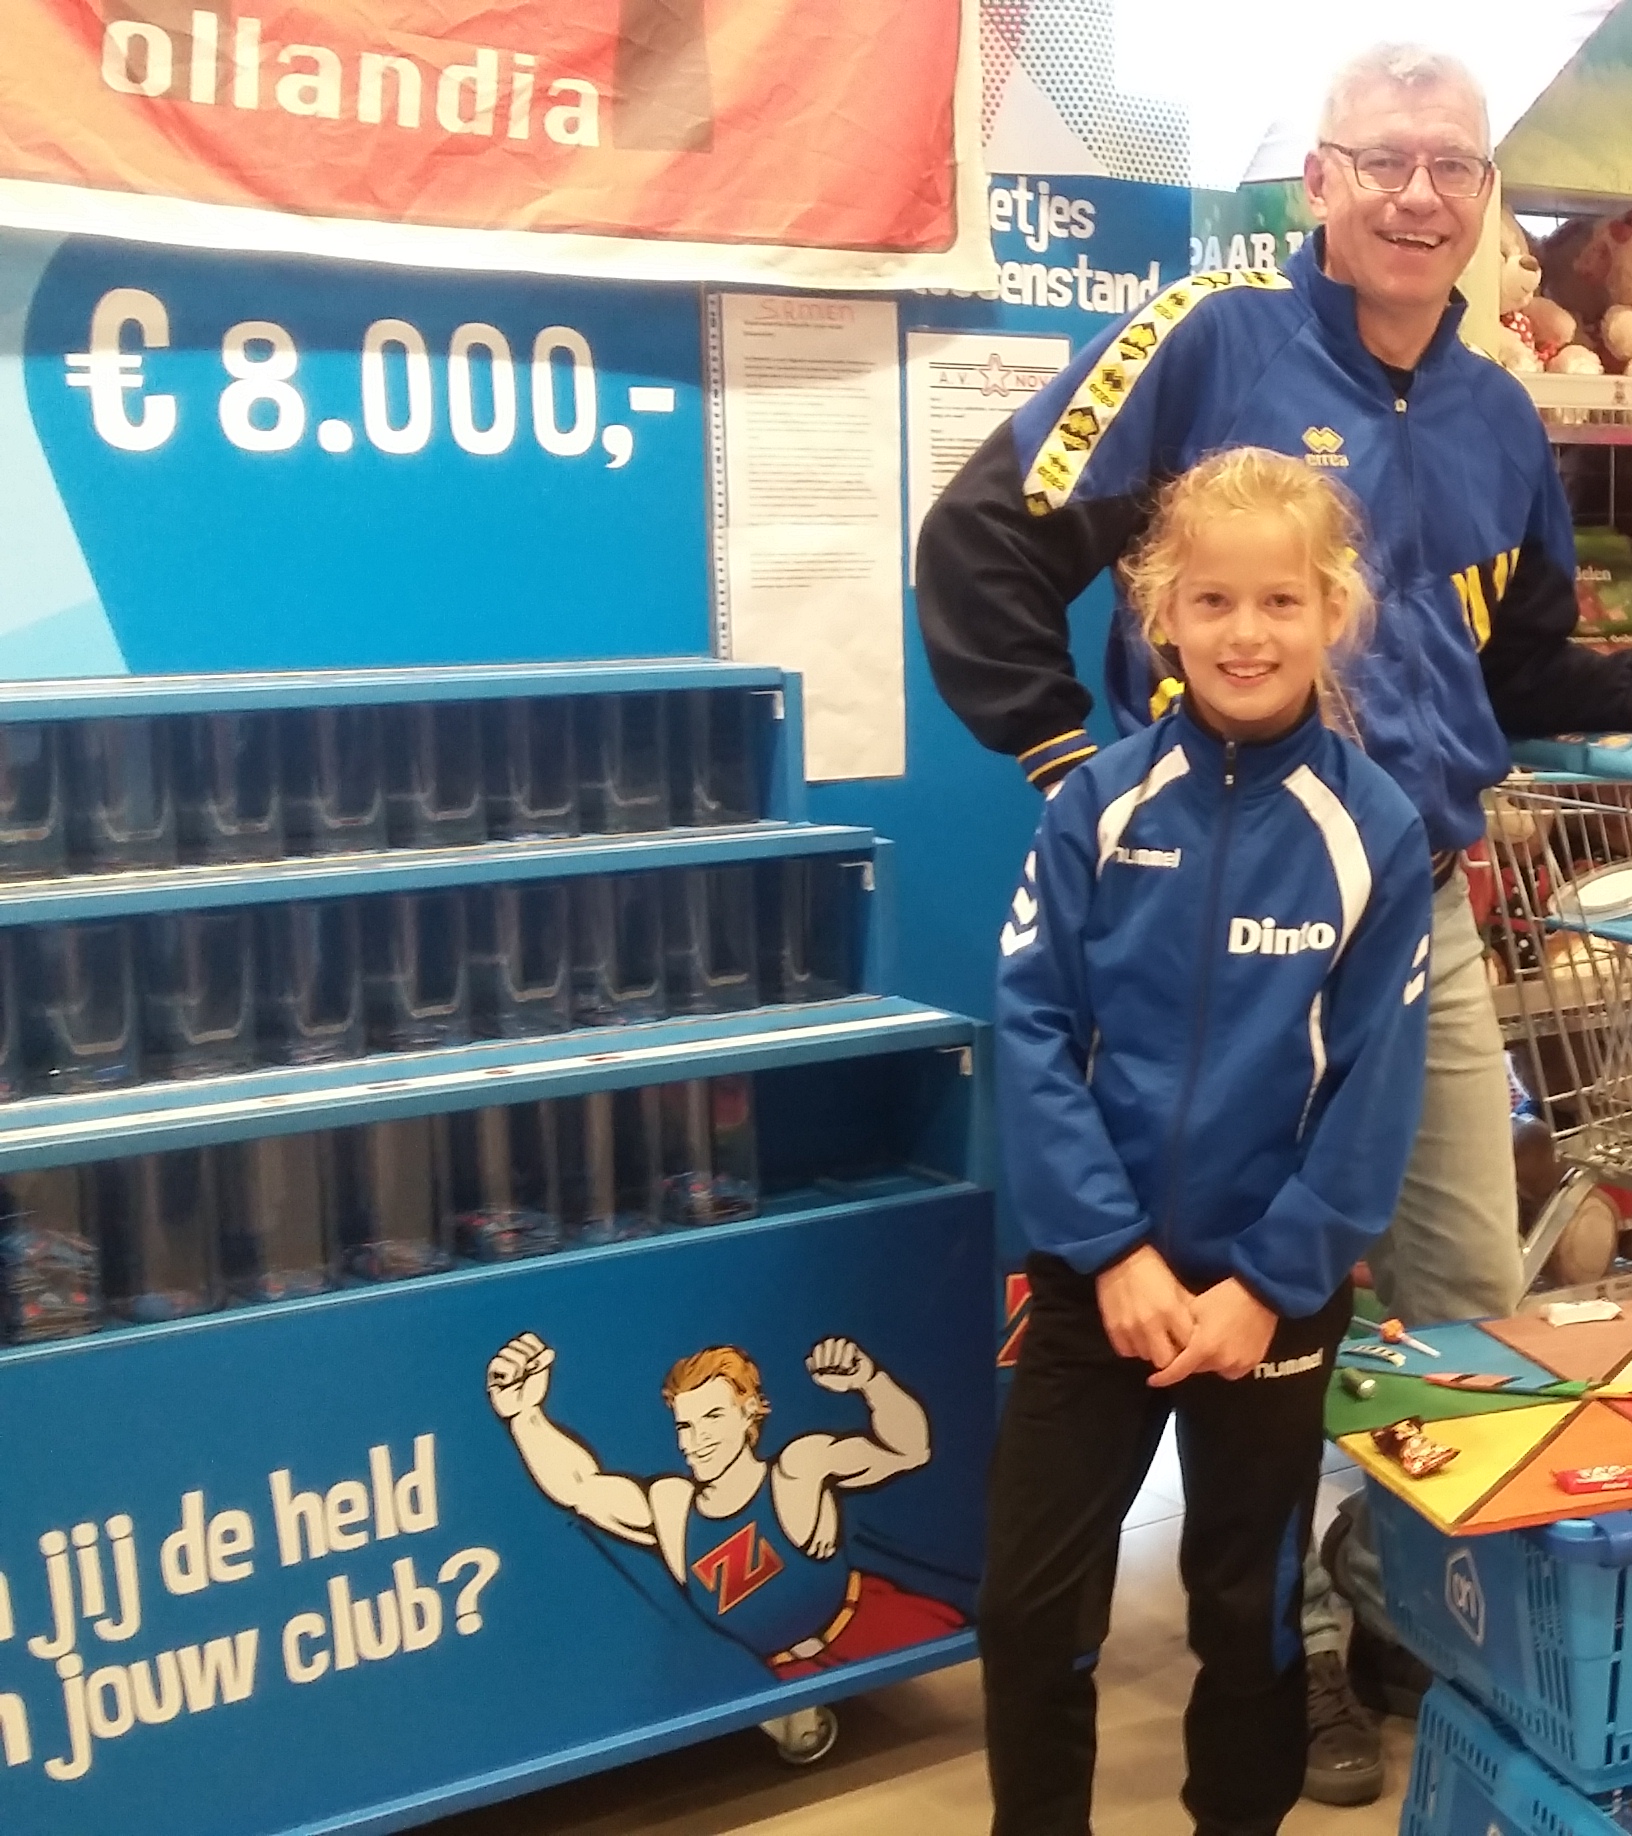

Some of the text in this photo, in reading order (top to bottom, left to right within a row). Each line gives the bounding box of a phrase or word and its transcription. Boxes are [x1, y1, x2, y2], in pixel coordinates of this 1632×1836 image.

[915, 253, 1160, 314] enstand
[65, 287, 177, 452] €
[218, 317, 676, 469] 8.000,-
[1228, 916, 1336, 955] Dinto
[27, 1513, 141, 1660] jij
[161, 1490, 254, 1596] de
[269, 1432, 440, 1567] held
[44, 1628, 259, 1781] jouw
[281, 1547, 501, 1685] club?
